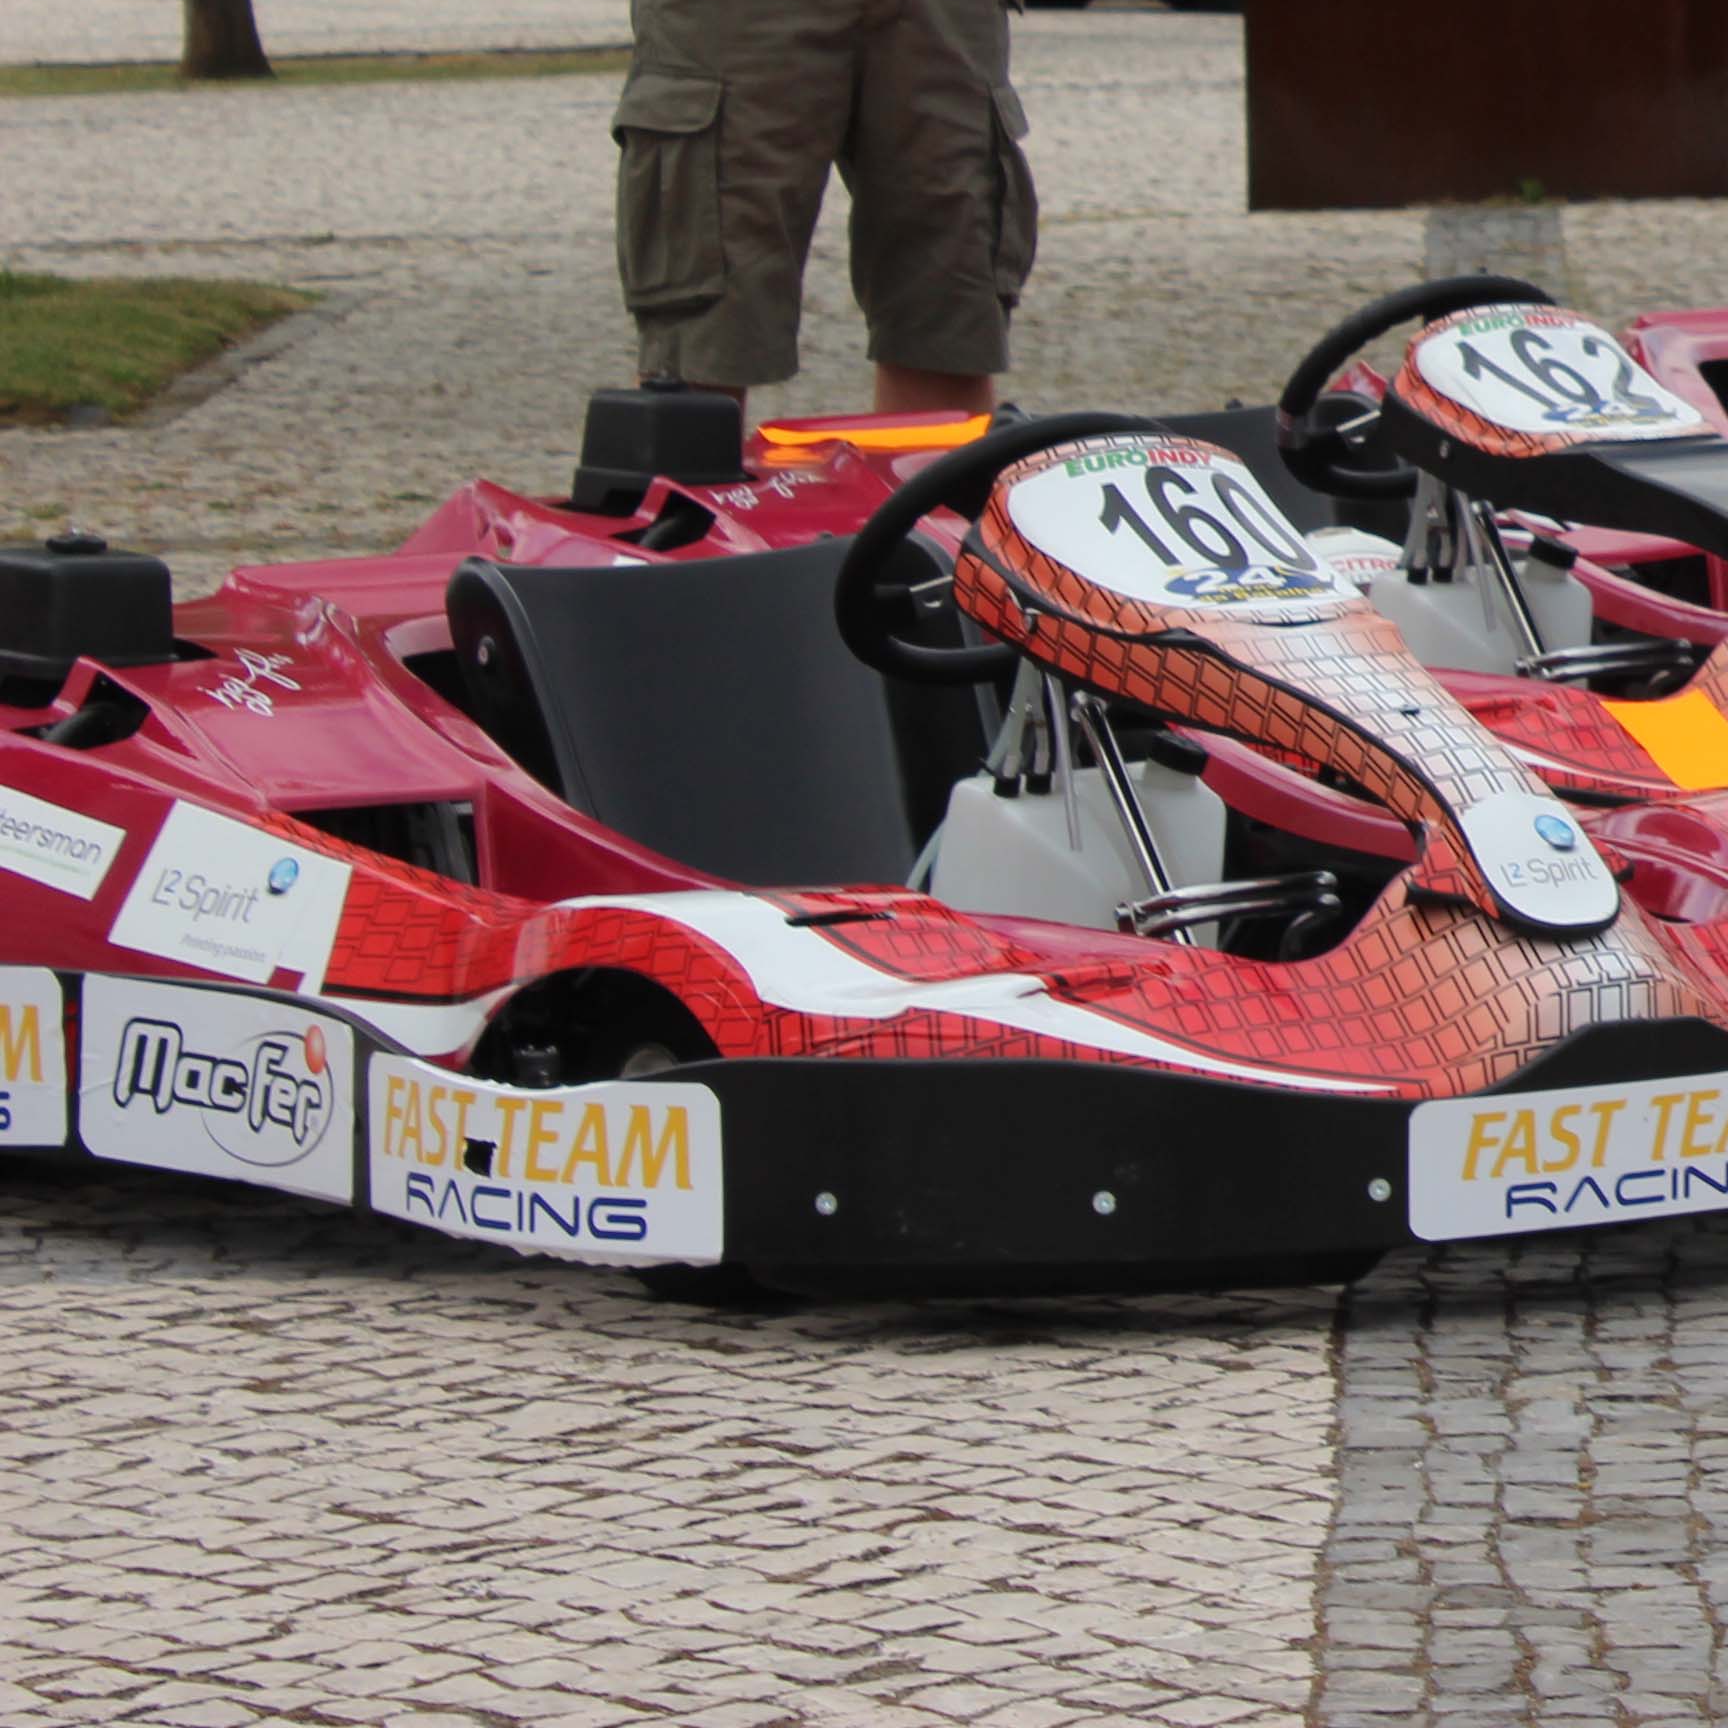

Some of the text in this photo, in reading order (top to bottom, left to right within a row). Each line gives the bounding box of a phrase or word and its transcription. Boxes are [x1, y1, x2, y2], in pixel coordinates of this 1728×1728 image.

[1454, 328, 1663, 415] 162
[1099, 466, 1318, 572] 160
[384, 1074, 694, 1190] FAST TEAM
[1461, 1098, 1628, 1182] FAST
[406, 1172, 648, 1241] RACING
